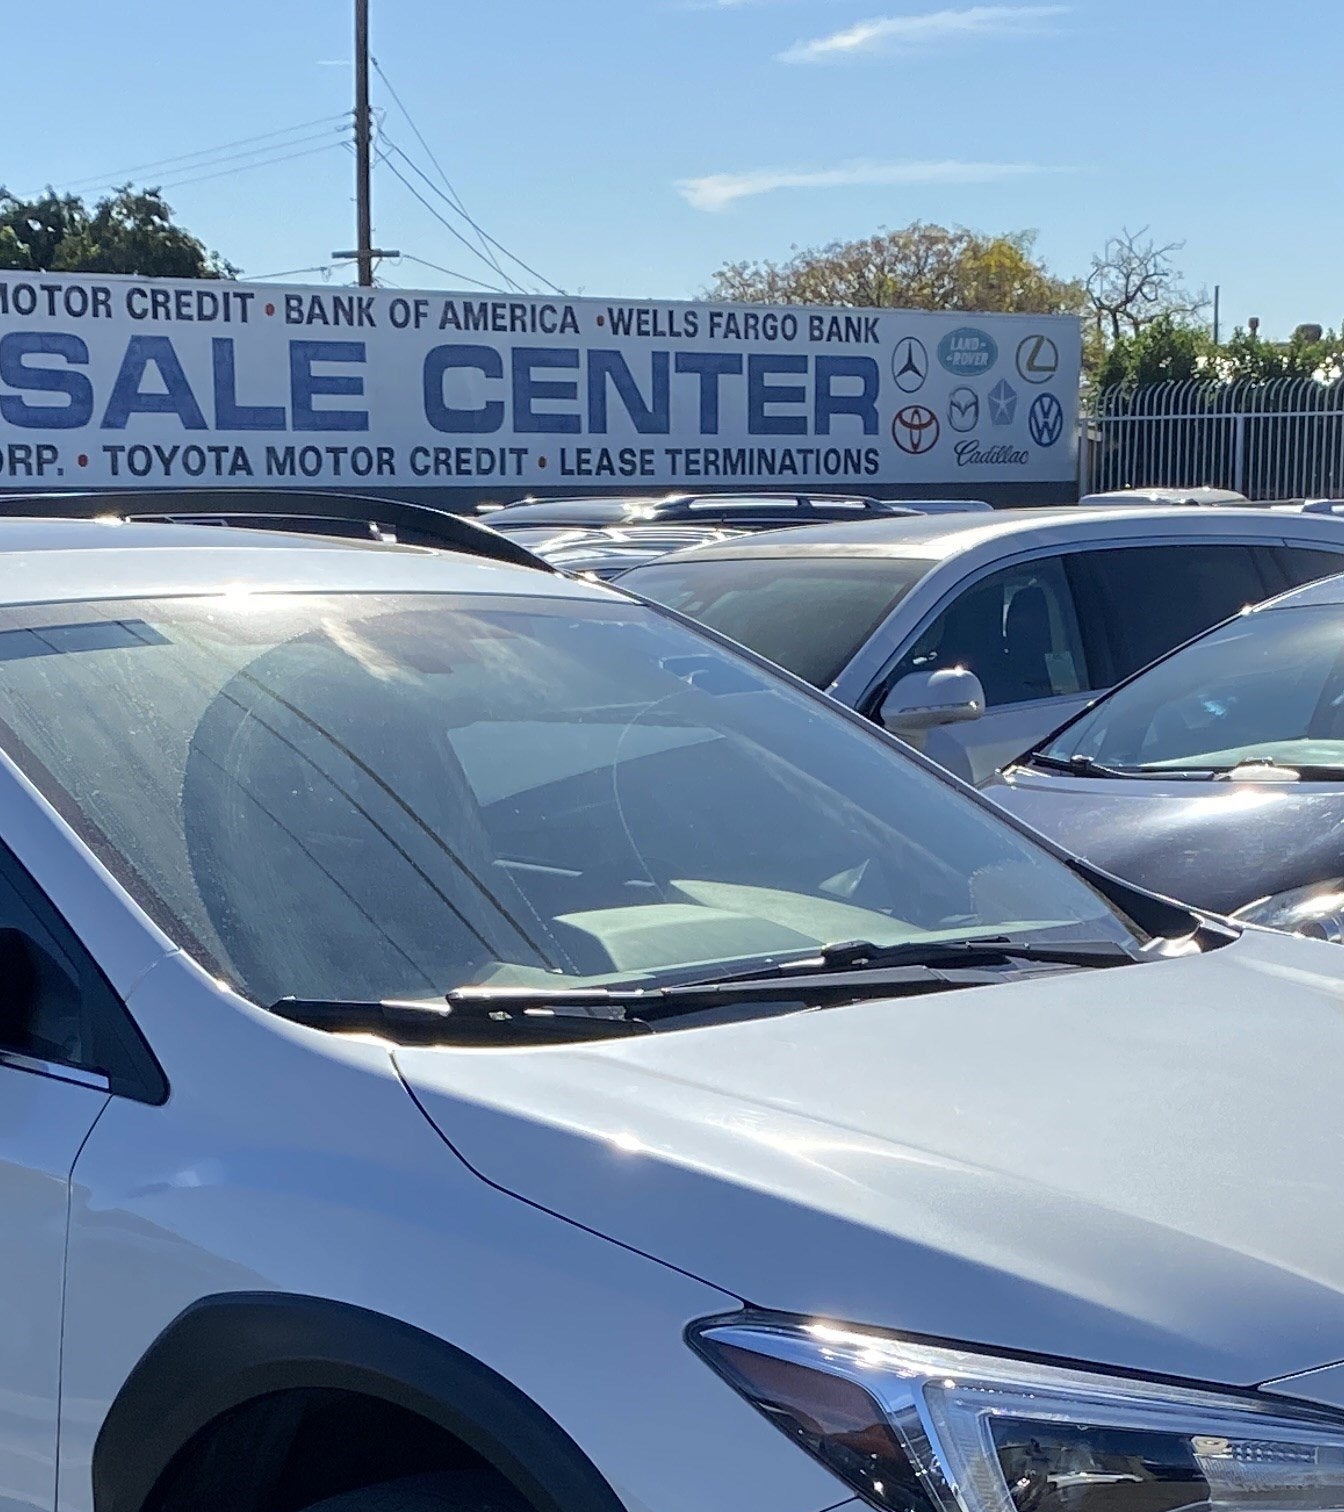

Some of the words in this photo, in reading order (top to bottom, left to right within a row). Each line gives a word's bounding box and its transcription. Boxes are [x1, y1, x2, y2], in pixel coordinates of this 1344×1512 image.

[127, 287, 254, 323] CREDIT
[285, 293, 377, 328] BANK
[389, 299, 429, 329] OF
[439, 301, 580, 335] AMERICA
[607, 307, 699, 338] WELLS
[709, 311, 798, 342] FARGO
[809, 315, 880, 345] BANK
[423, 343, 880, 435] CENTER
[102, 444, 253, 477] TOYOTA
[266, 446, 396, 477] MOTOR
[409, 446, 529, 477] CREDIT
[560, 447, 655, 477] LEASE
[665, 447, 880, 476] TERMINATIONS
[954, 440, 1030, 467] Cadillac
